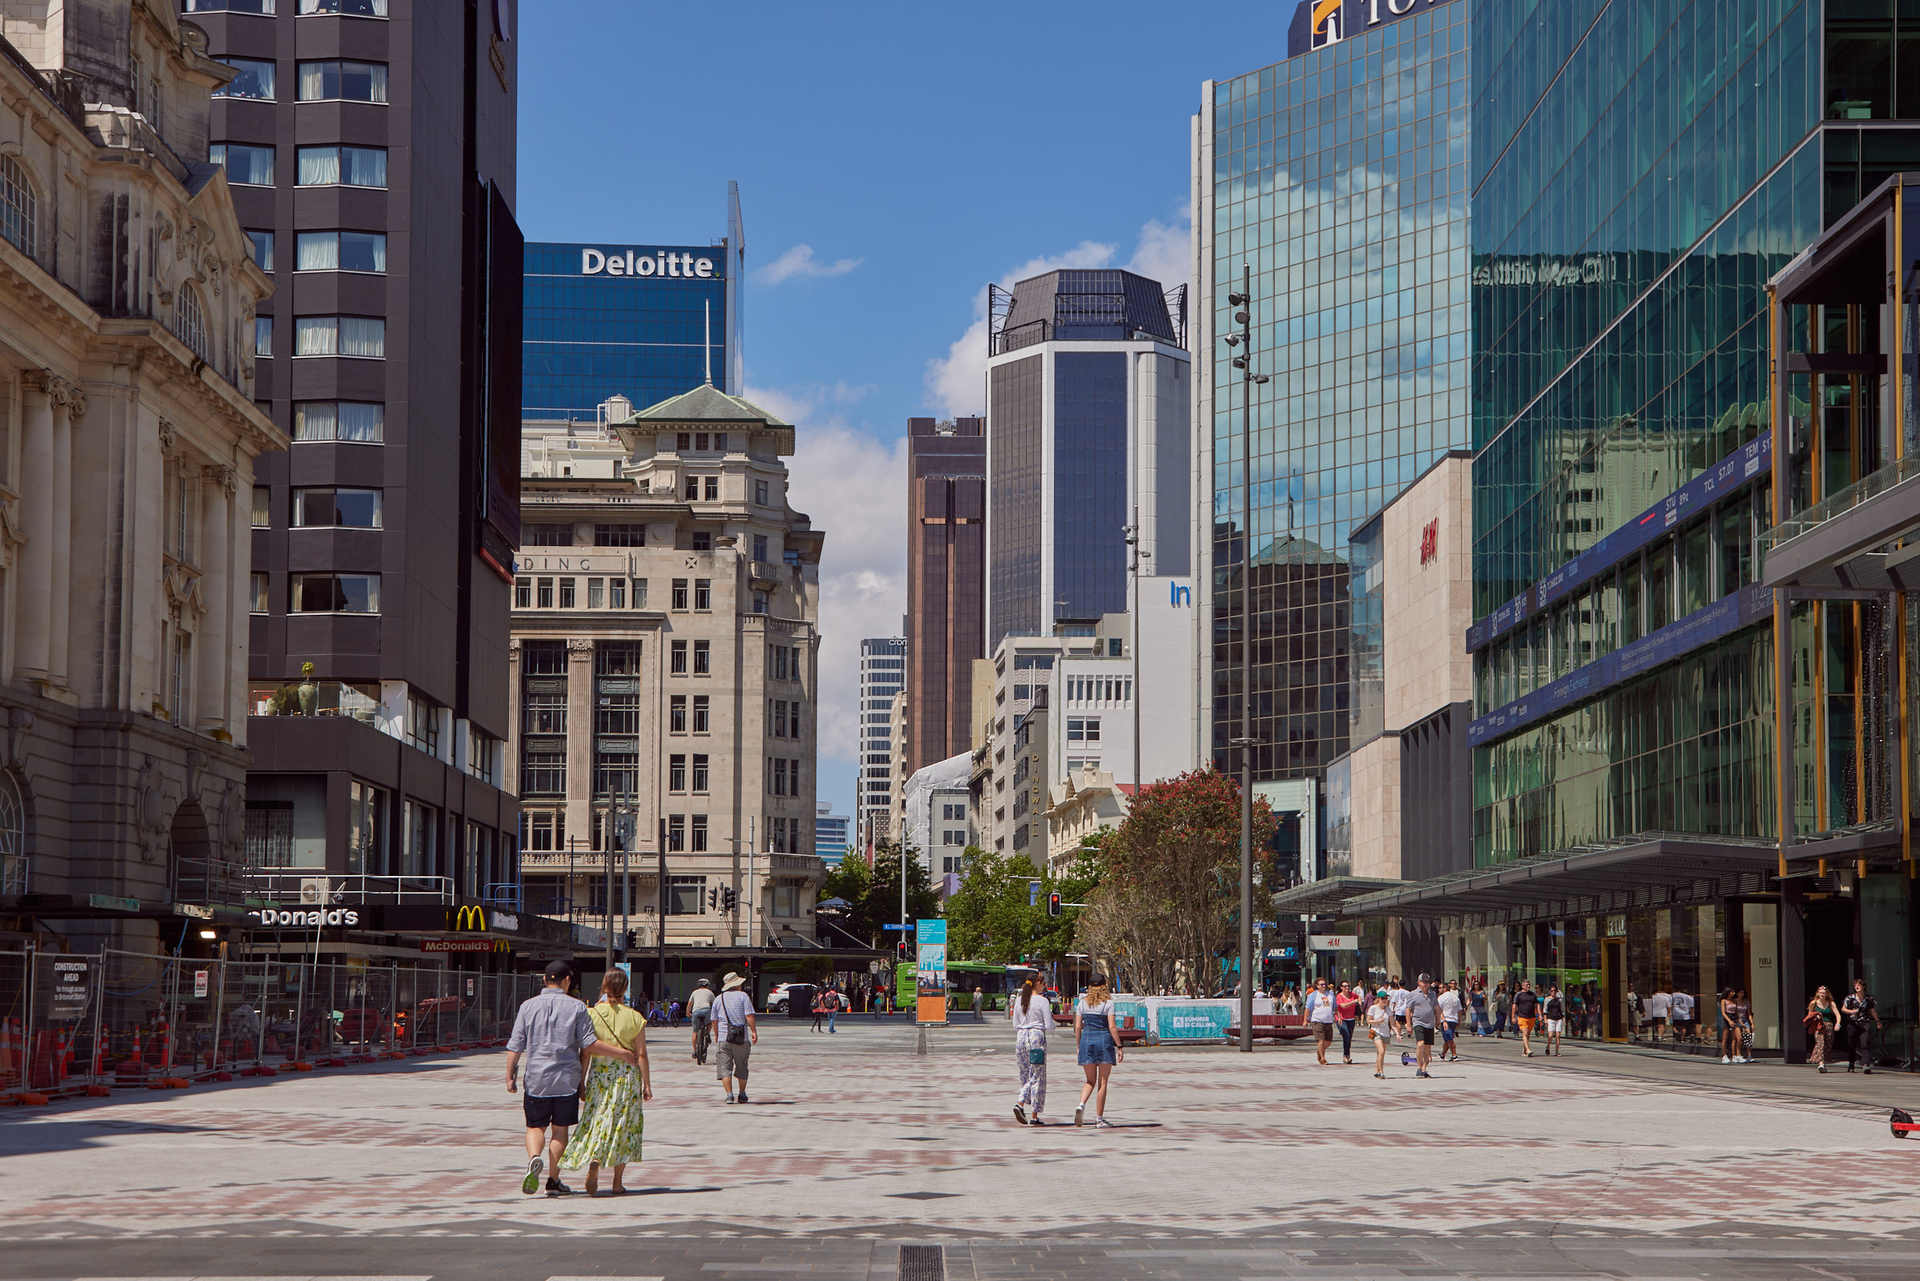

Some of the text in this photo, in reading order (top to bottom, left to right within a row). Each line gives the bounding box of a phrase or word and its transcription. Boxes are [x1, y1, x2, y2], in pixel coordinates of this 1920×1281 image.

[1704, 478, 1715, 493] TCL
[1665, 496, 1676, 511] STU
[425, 941, 490, 951] McDonald's
[1267, 948, 1286, 957] ANZ
[54, 962, 88, 971] CONSTRUCTION
